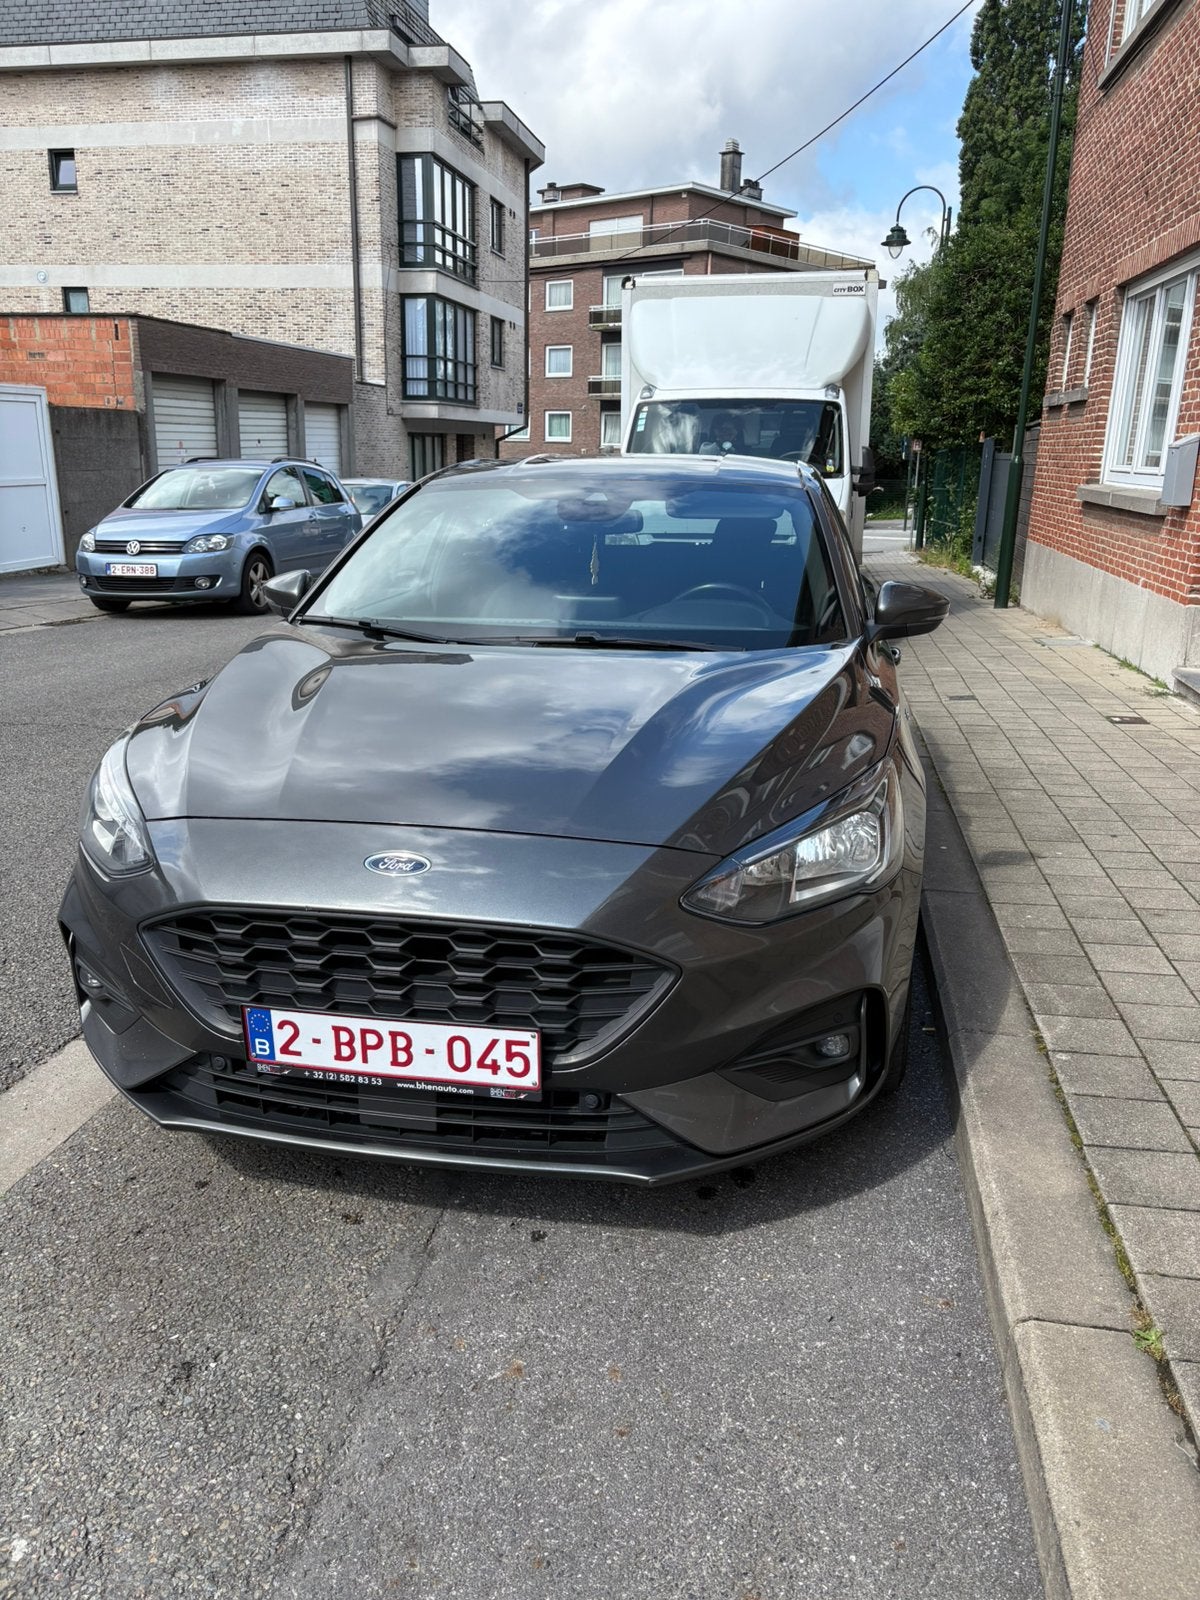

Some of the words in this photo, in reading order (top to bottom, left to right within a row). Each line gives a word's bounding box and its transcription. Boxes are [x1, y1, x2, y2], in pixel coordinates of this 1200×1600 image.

[378, 856, 416, 871] Ford
[255, 1038, 270, 1055] B
[276, 1019, 531, 1078] 2-BPB-045
[313, 1071, 323, 1079] 32
[325, 1072, 337, 1081] (2)
[357, 1076, 369, 1084] 83
[371, 1077, 382, 1086] 53
[396, 1081, 474, 1095] www.bhenauto.com
